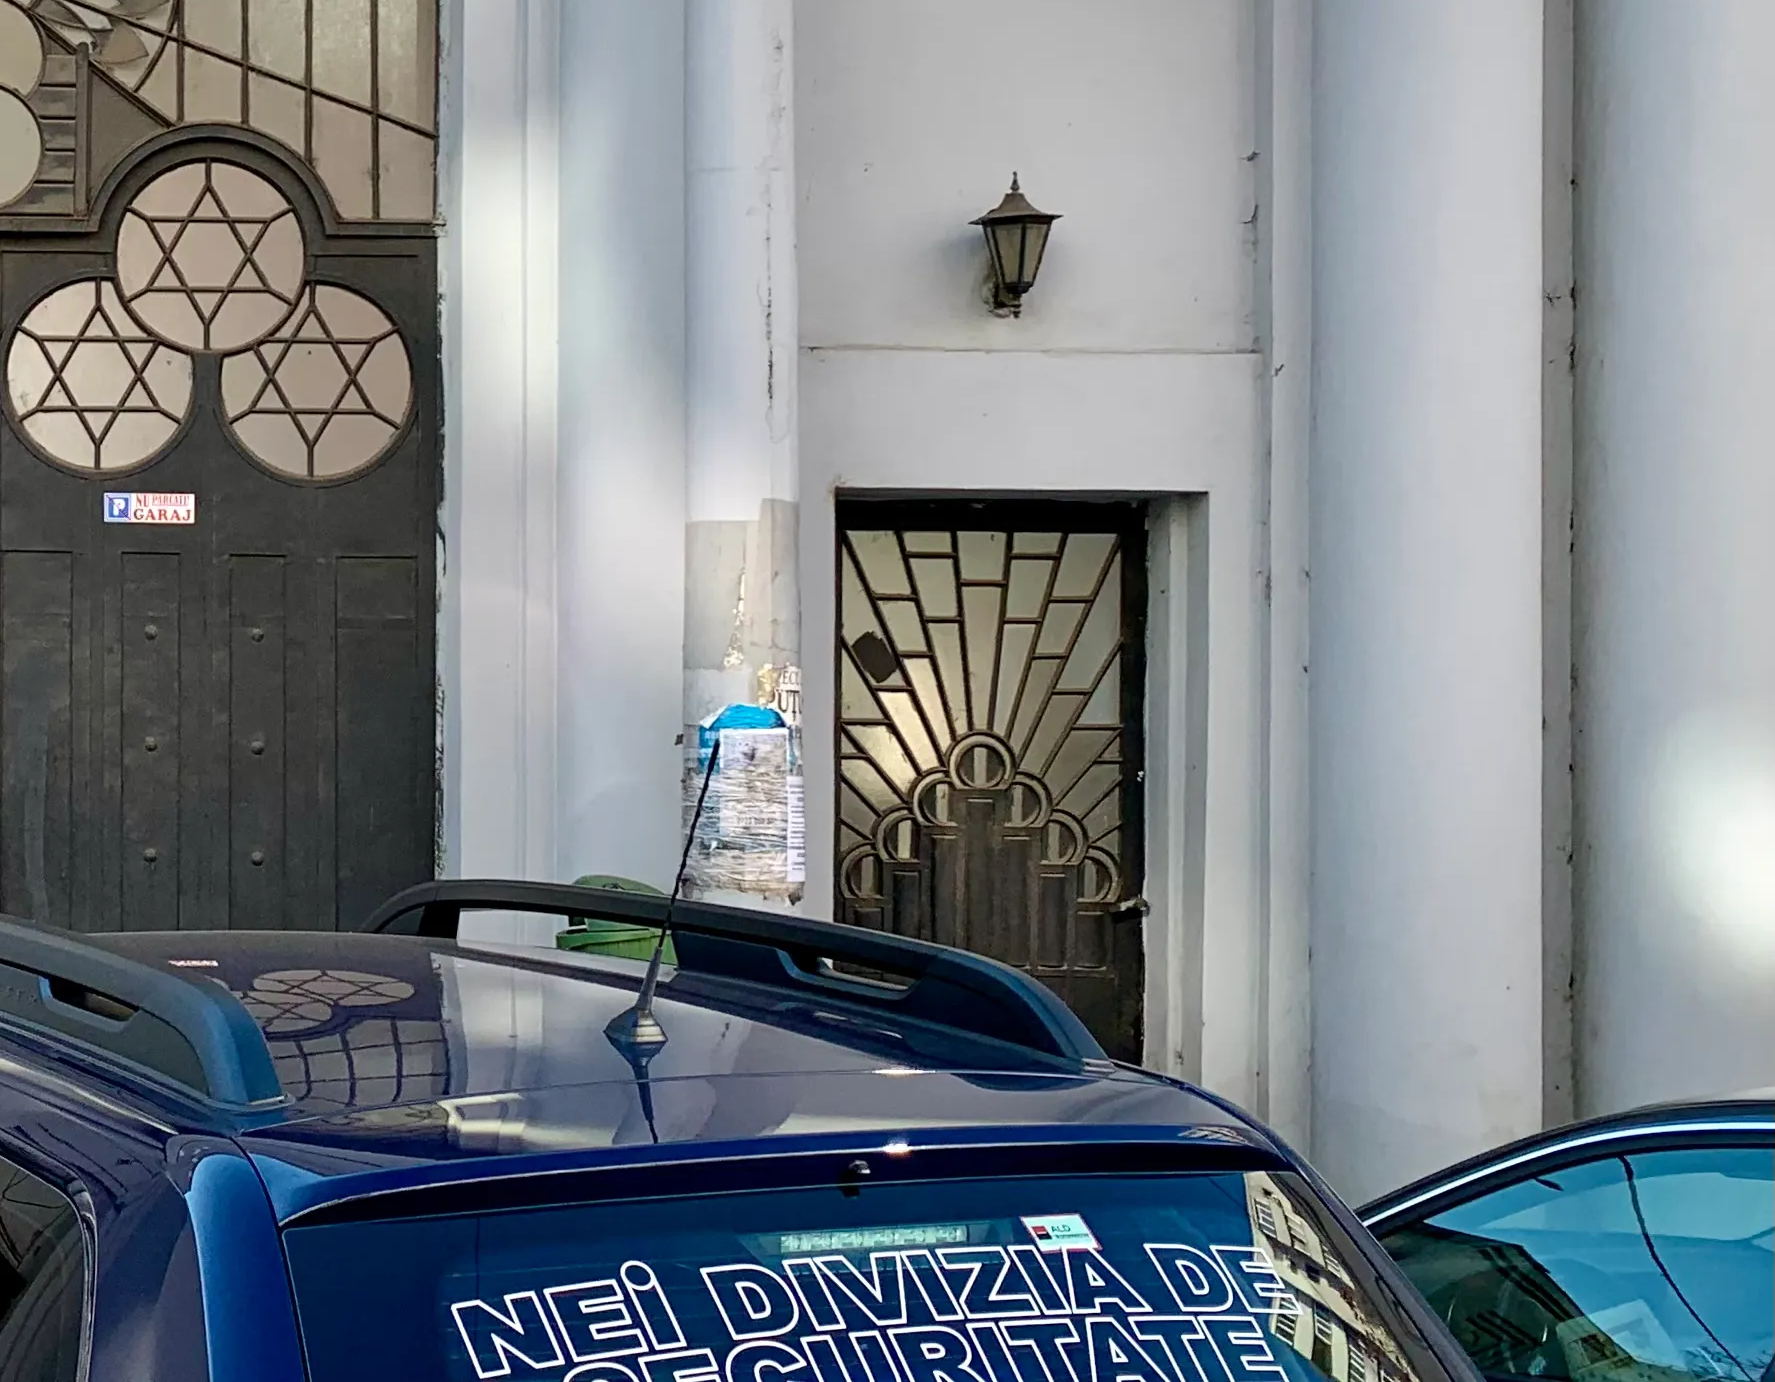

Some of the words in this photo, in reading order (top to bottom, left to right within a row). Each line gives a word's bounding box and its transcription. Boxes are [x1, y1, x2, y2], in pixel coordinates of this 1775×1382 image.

[136, 494, 149, 507] NU
[133, 508, 192, 521] GARAJ
[1051, 1224, 1071, 1233] ALD
[700, 1244, 1152, 1340] DIVIZIA
[1143, 1243, 1304, 1316] DE
